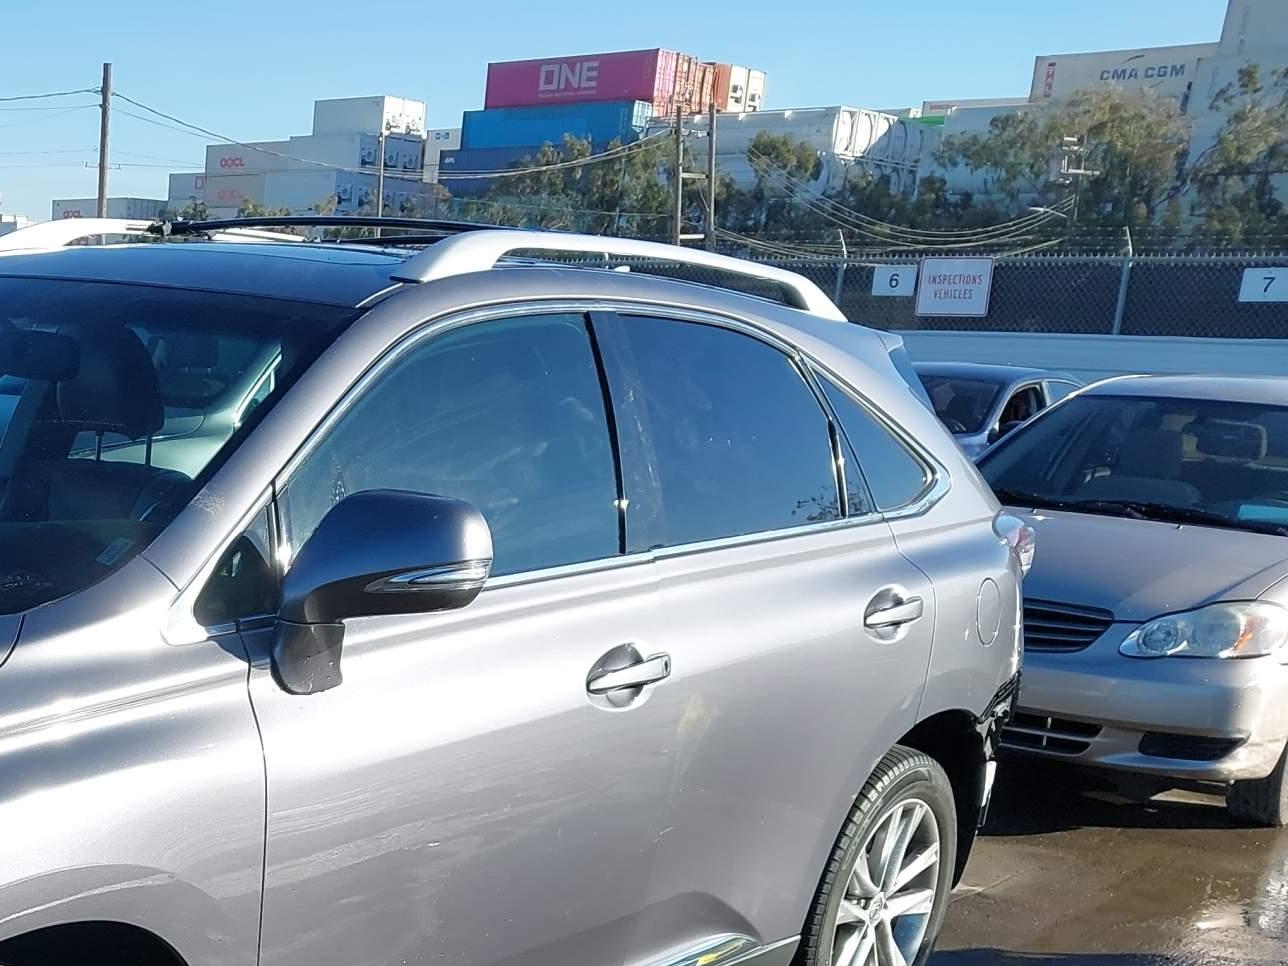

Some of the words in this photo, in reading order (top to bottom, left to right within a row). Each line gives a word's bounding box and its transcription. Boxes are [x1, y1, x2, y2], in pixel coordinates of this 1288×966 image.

[538, 61, 600, 91] ONE
[1100, 69, 1138, 81] CMA
[1144, 64, 1186, 79] CGM
[888, 273, 900, 288] 6
[927, 273, 983, 286] INSPECTIONS
[1263, 276, 1276, 293] 7
[933, 288, 974, 300] VEHICLES
